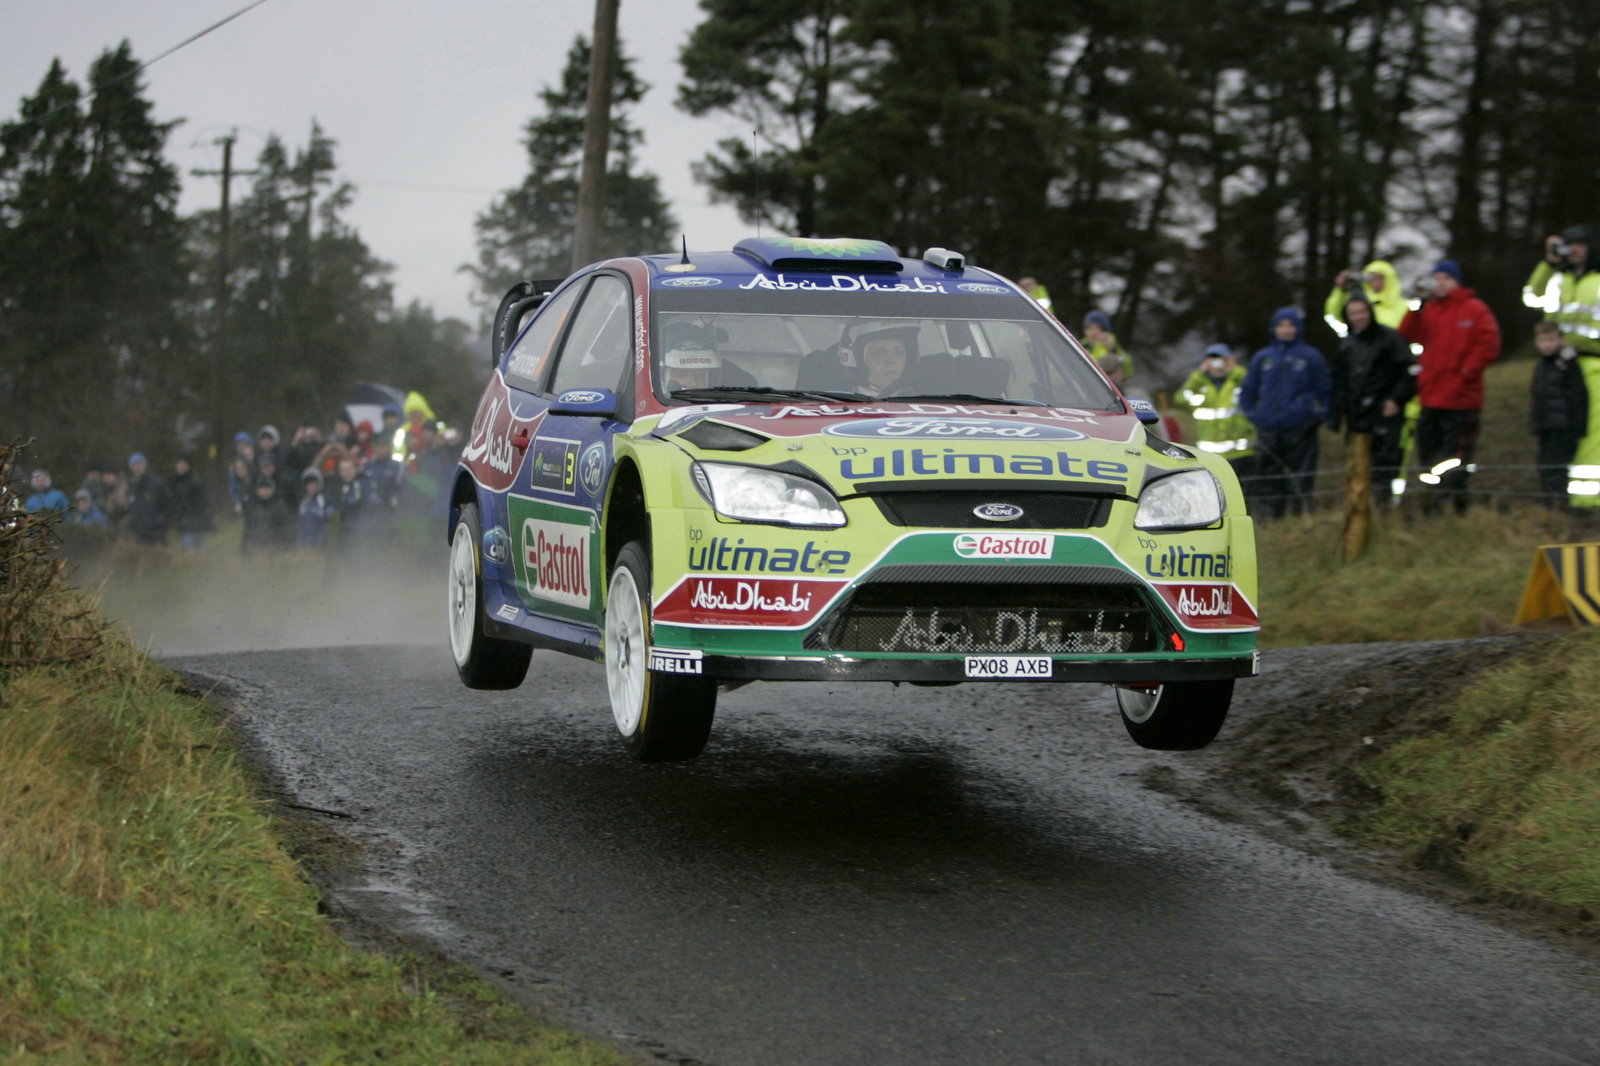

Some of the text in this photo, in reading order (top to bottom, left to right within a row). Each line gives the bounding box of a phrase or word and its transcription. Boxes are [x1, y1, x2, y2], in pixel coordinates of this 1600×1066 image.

[565, 394, 597, 402] Ford
[877, 419, 1041, 438] Ford
[834, 446, 868, 457] bp
[565, 452, 575, 485] 3
[840, 449, 1129, 481] ultimate
[985, 505, 1014, 517] Ford
[689, 525, 704, 543] bp
[1137, 536, 1158, 551] bp
[689, 537, 851, 574] ultimate
[979, 536, 1048, 556] Castrol
[537, 529, 588, 597] Castrol
[1145, 545, 1233, 578] ultimat
[967, 659, 1050, 675] PX08 AXB
